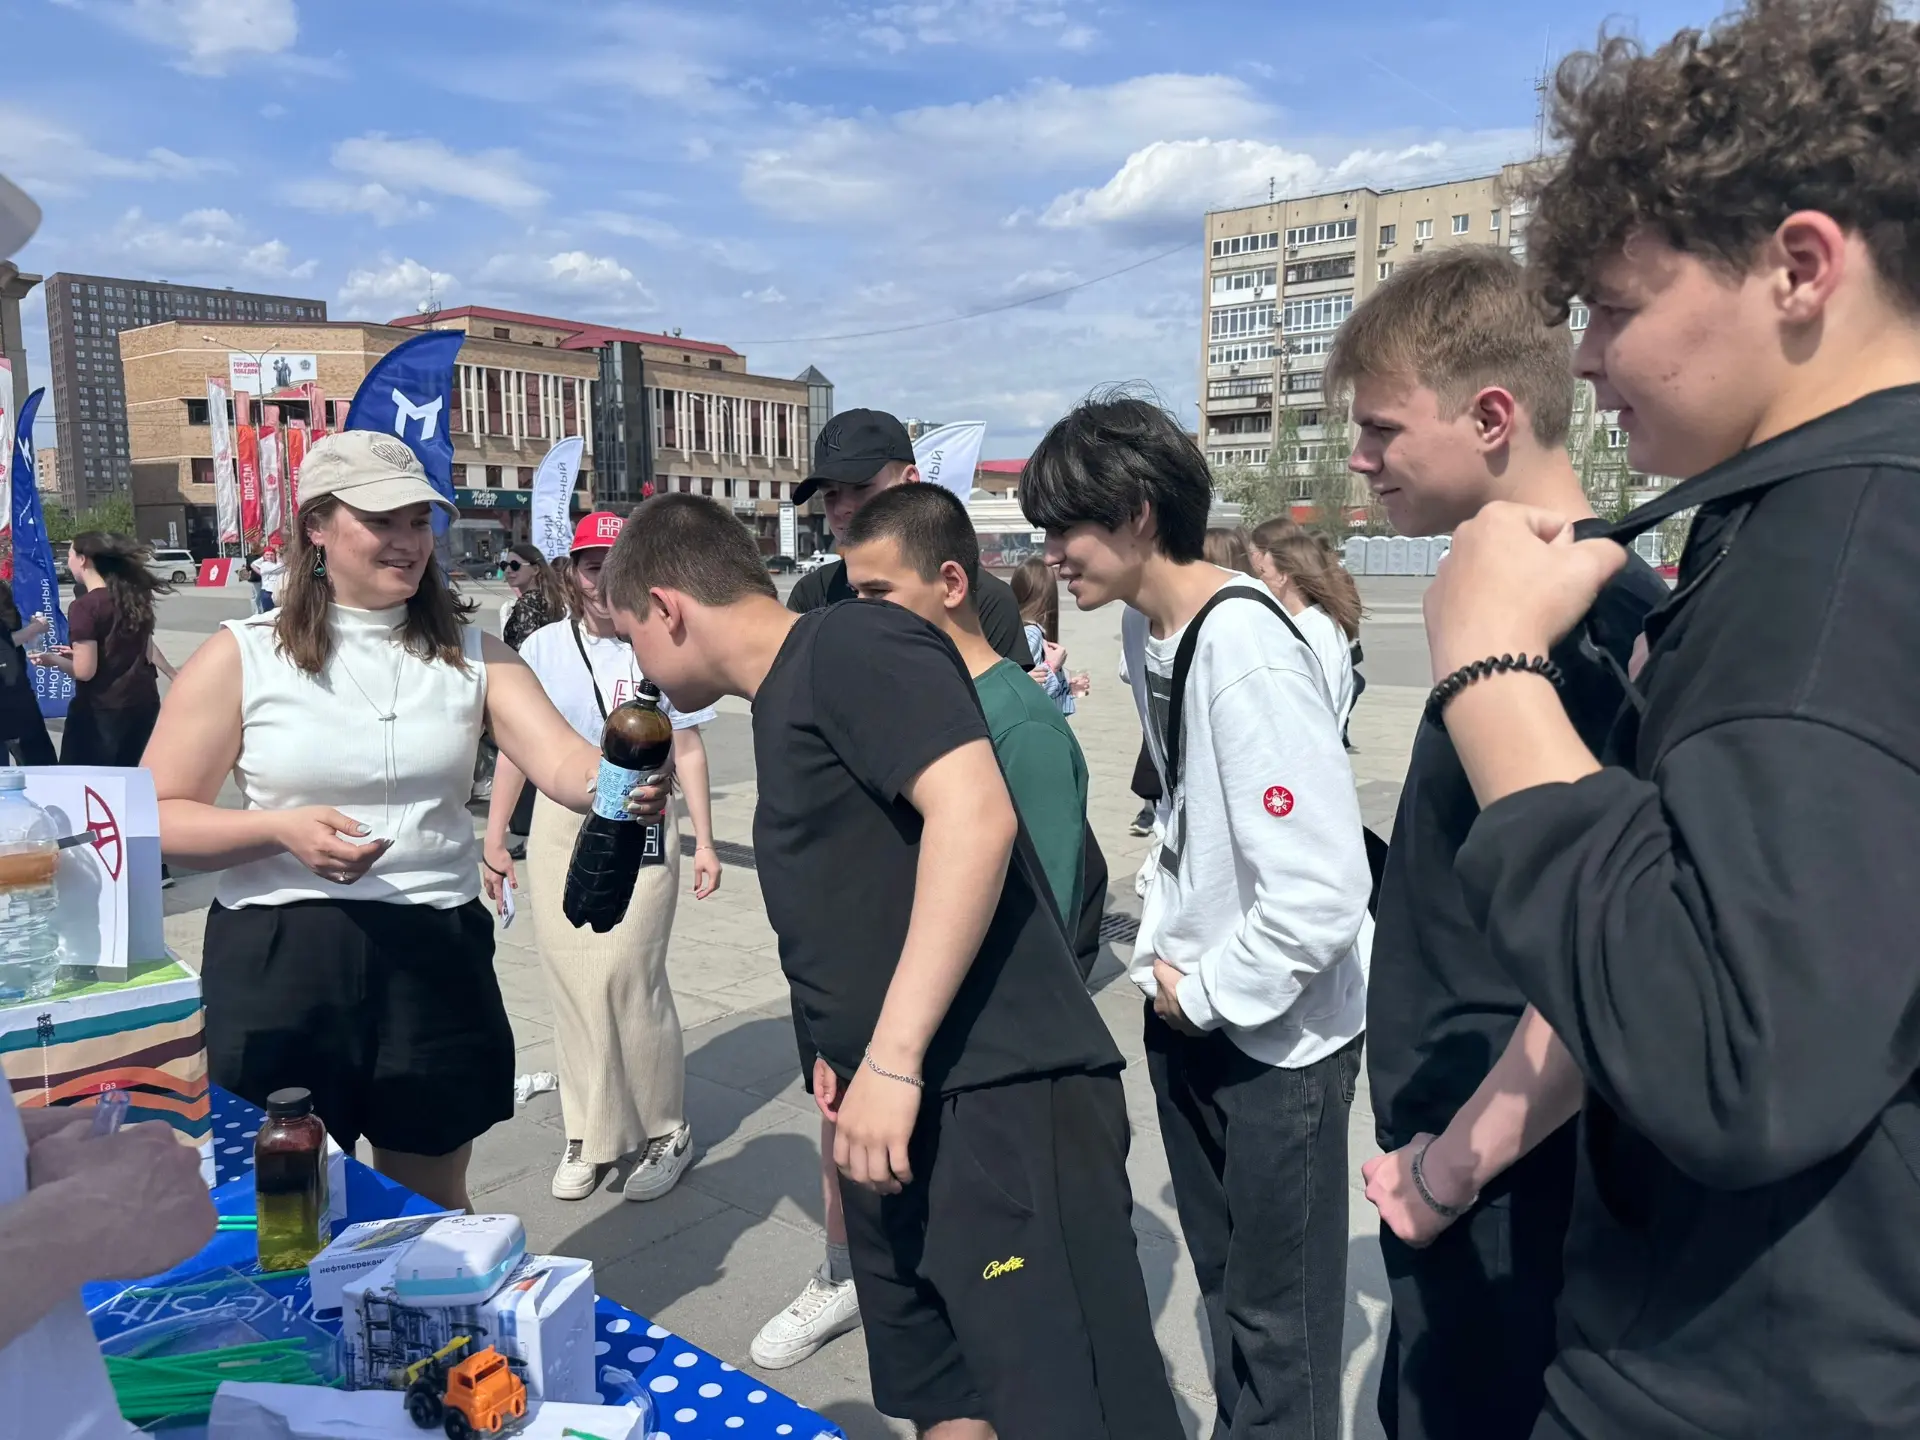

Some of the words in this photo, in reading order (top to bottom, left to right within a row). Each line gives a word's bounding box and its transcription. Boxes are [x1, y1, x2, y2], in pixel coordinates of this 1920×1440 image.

[243, 463, 255, 500] ПОБЕДА!
[928, 450, 944, 484] НЫЙ
[100, 1082, 117, 1092] Газ
